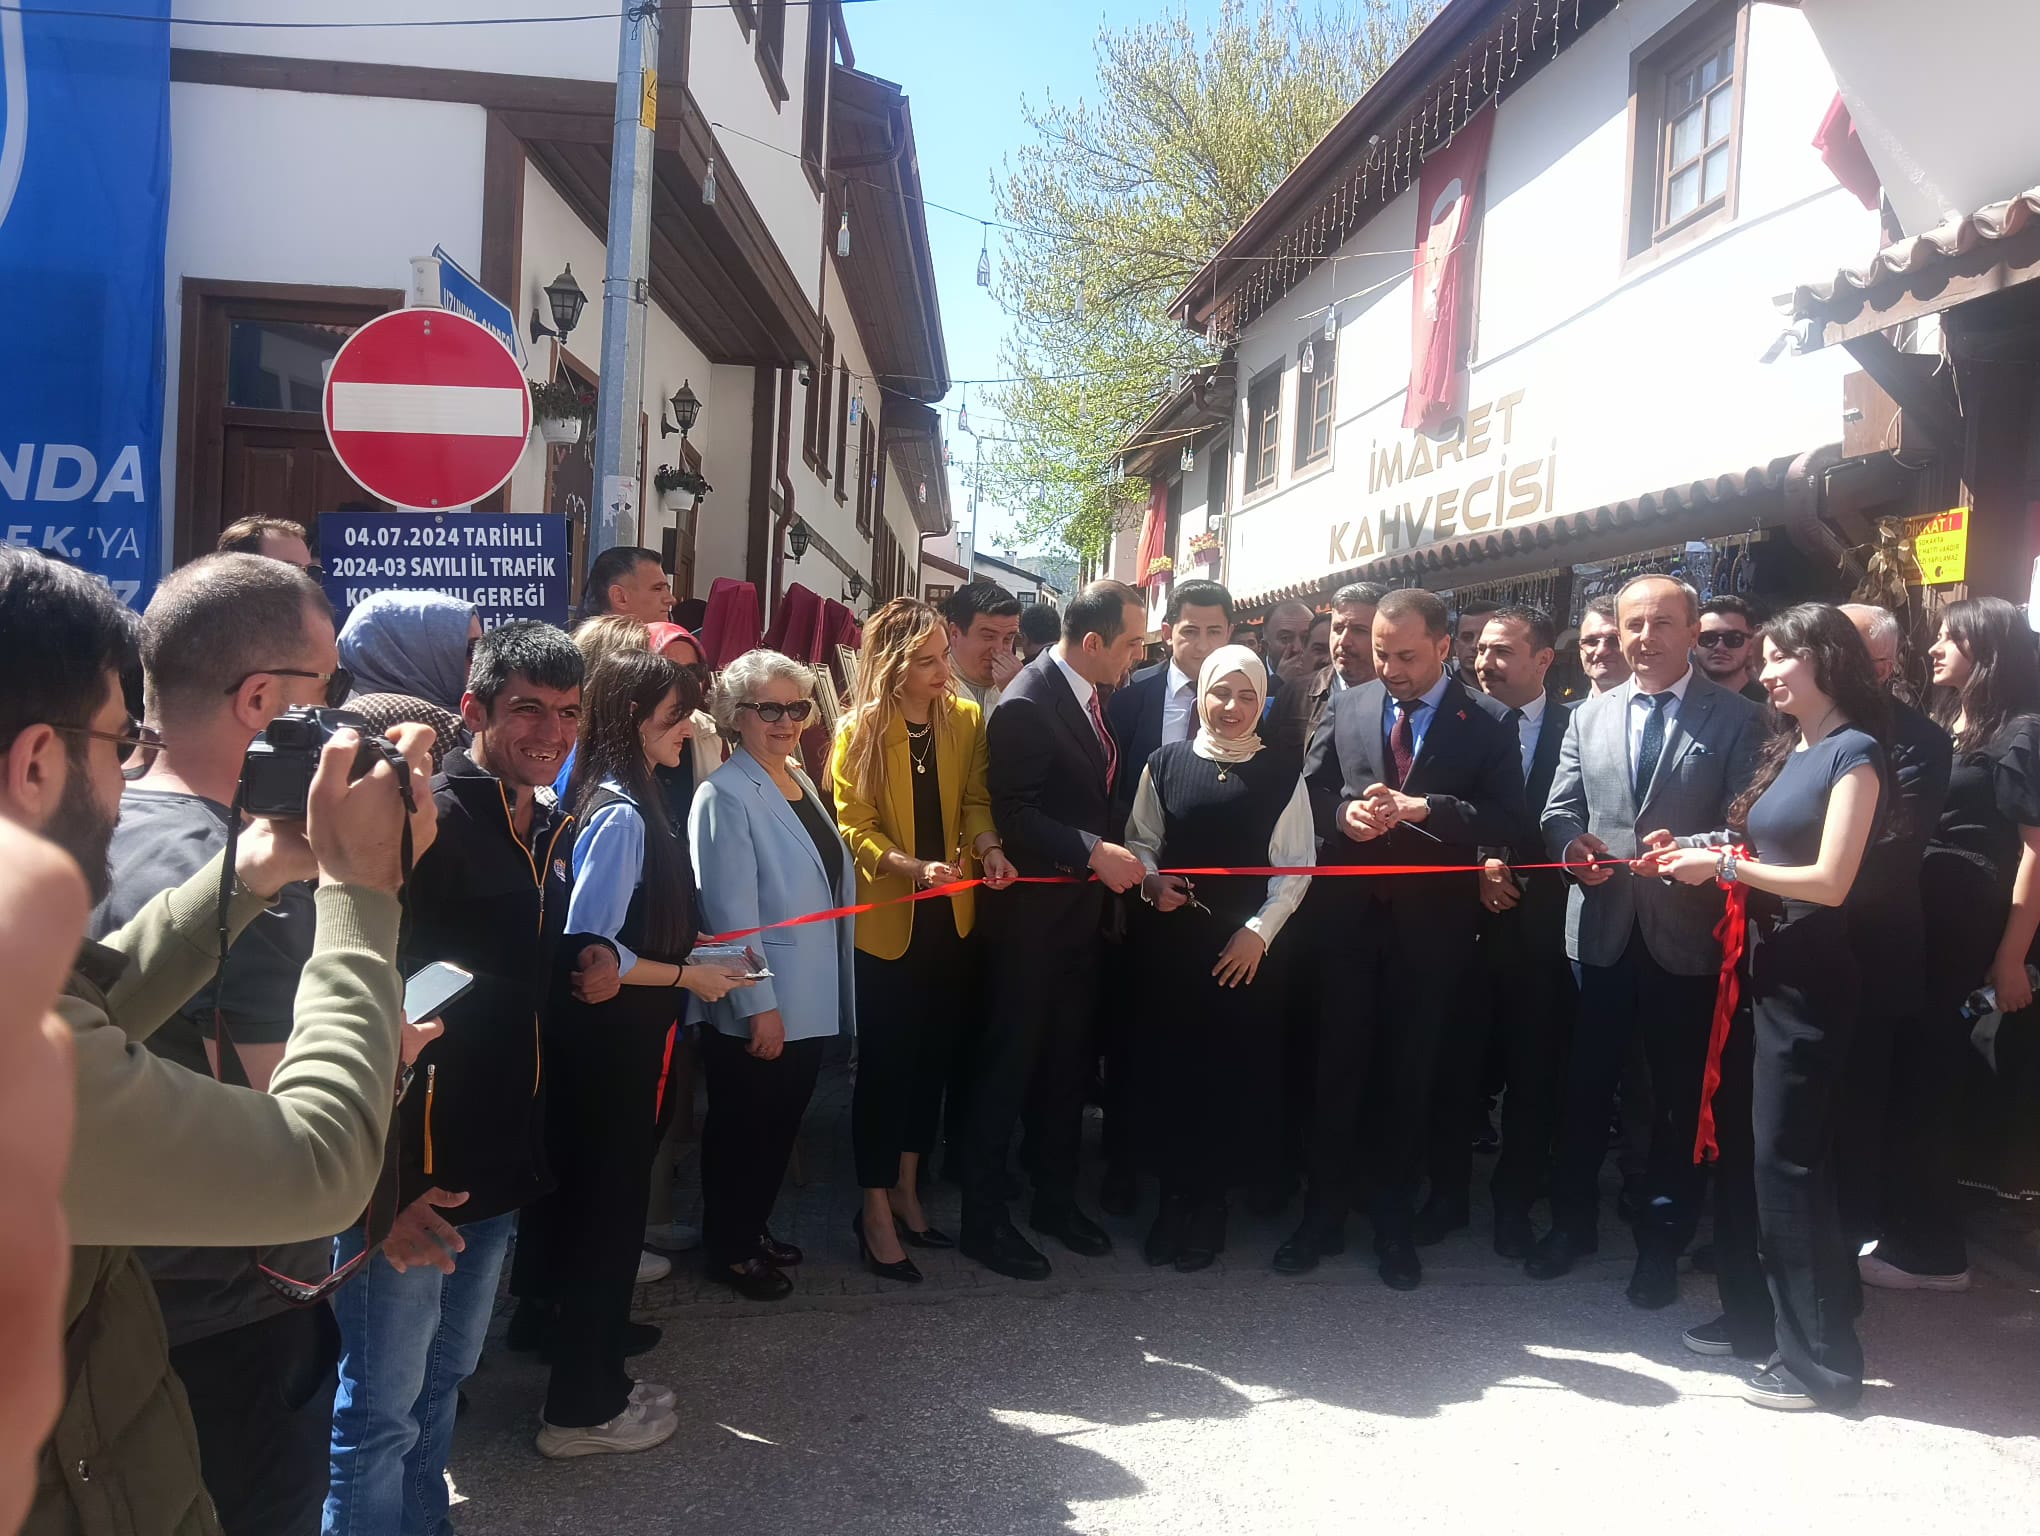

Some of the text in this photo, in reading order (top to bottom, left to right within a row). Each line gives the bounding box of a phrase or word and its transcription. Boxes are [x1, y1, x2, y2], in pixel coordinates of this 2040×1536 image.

[1368, 388, 1526, 494] İMARET
[1328, 436, 1557, 564] KAHVECİSİ
[344, 522, 542, 547] 04.07.2024 TARİHLİ
[332, 552, 556, 577] 2024-03 SAYILI İL TRAFİK
[473, 583, 545, 607] GEREĞİ
